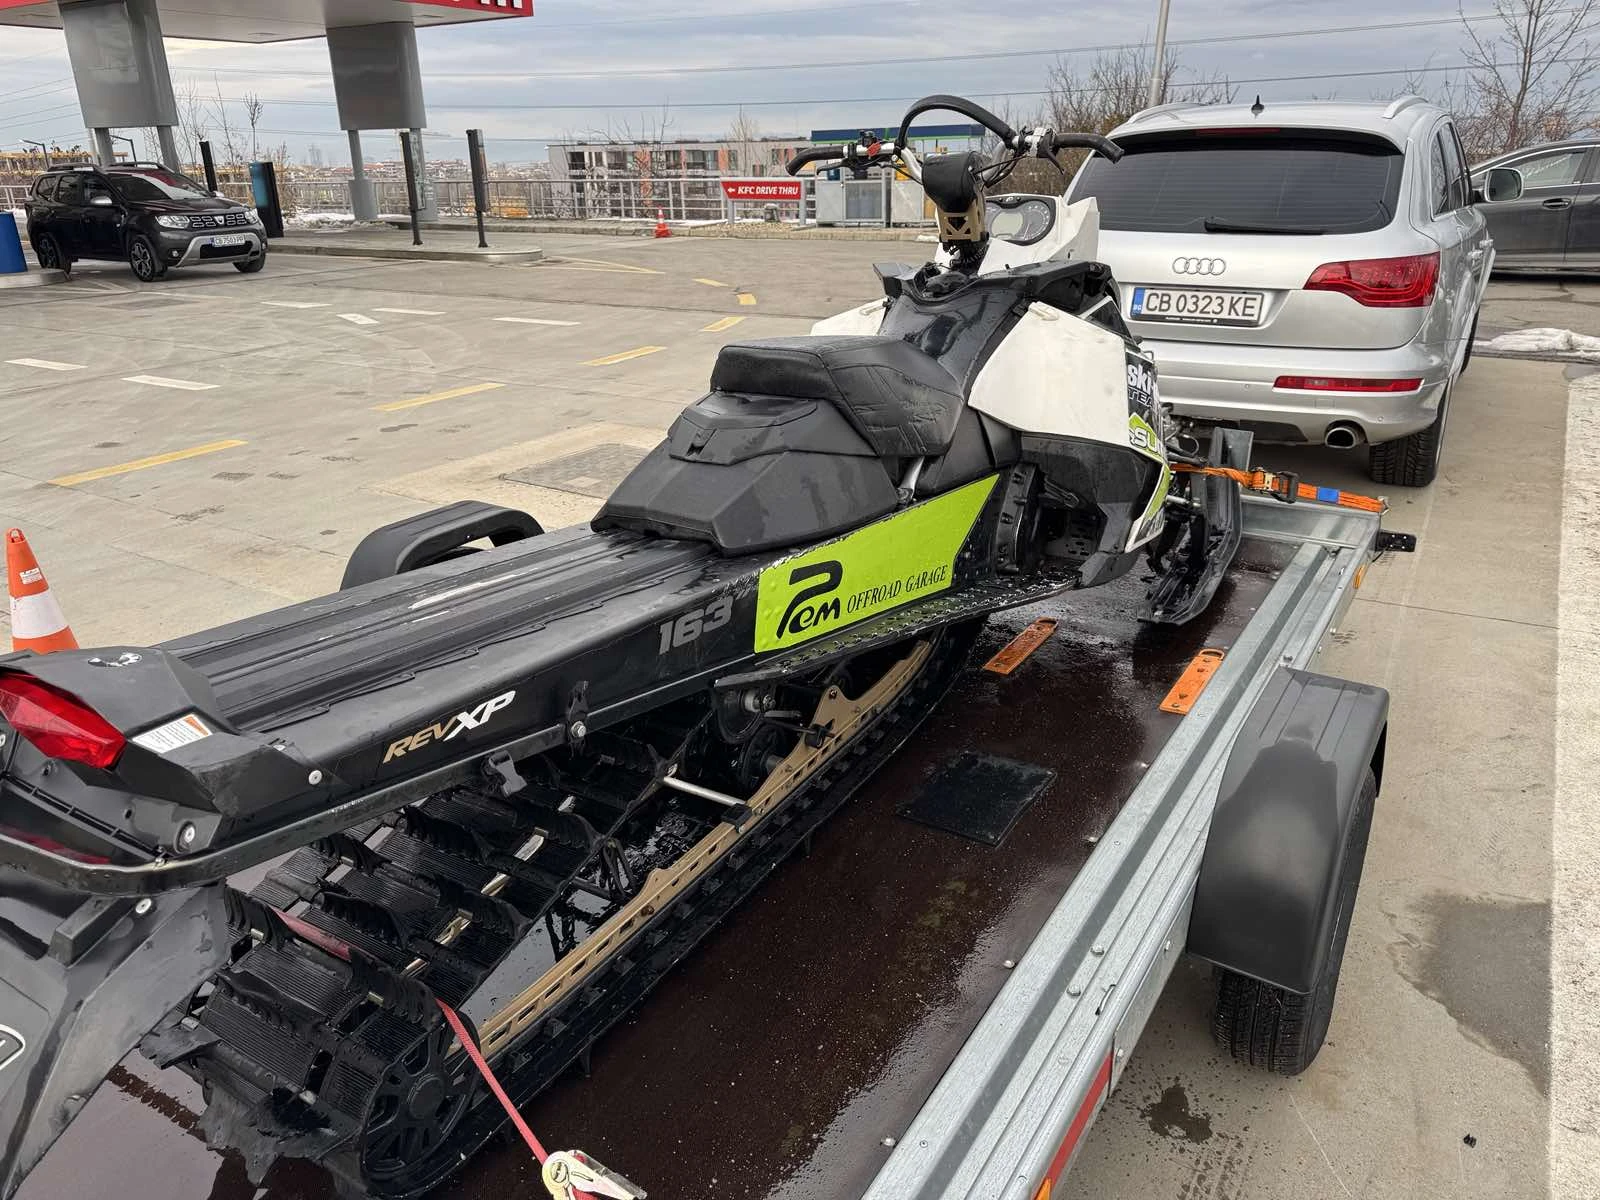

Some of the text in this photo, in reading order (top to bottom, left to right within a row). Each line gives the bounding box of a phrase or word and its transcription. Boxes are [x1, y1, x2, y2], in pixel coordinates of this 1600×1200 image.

[738, 186, 799, 195] KFC DRIVE THRU
[1145, 293, 1257, 317] CB 0323 KE
[847, 579, 902, 614] OFFROAD
[905, 564, 948, 592] GARAGE
